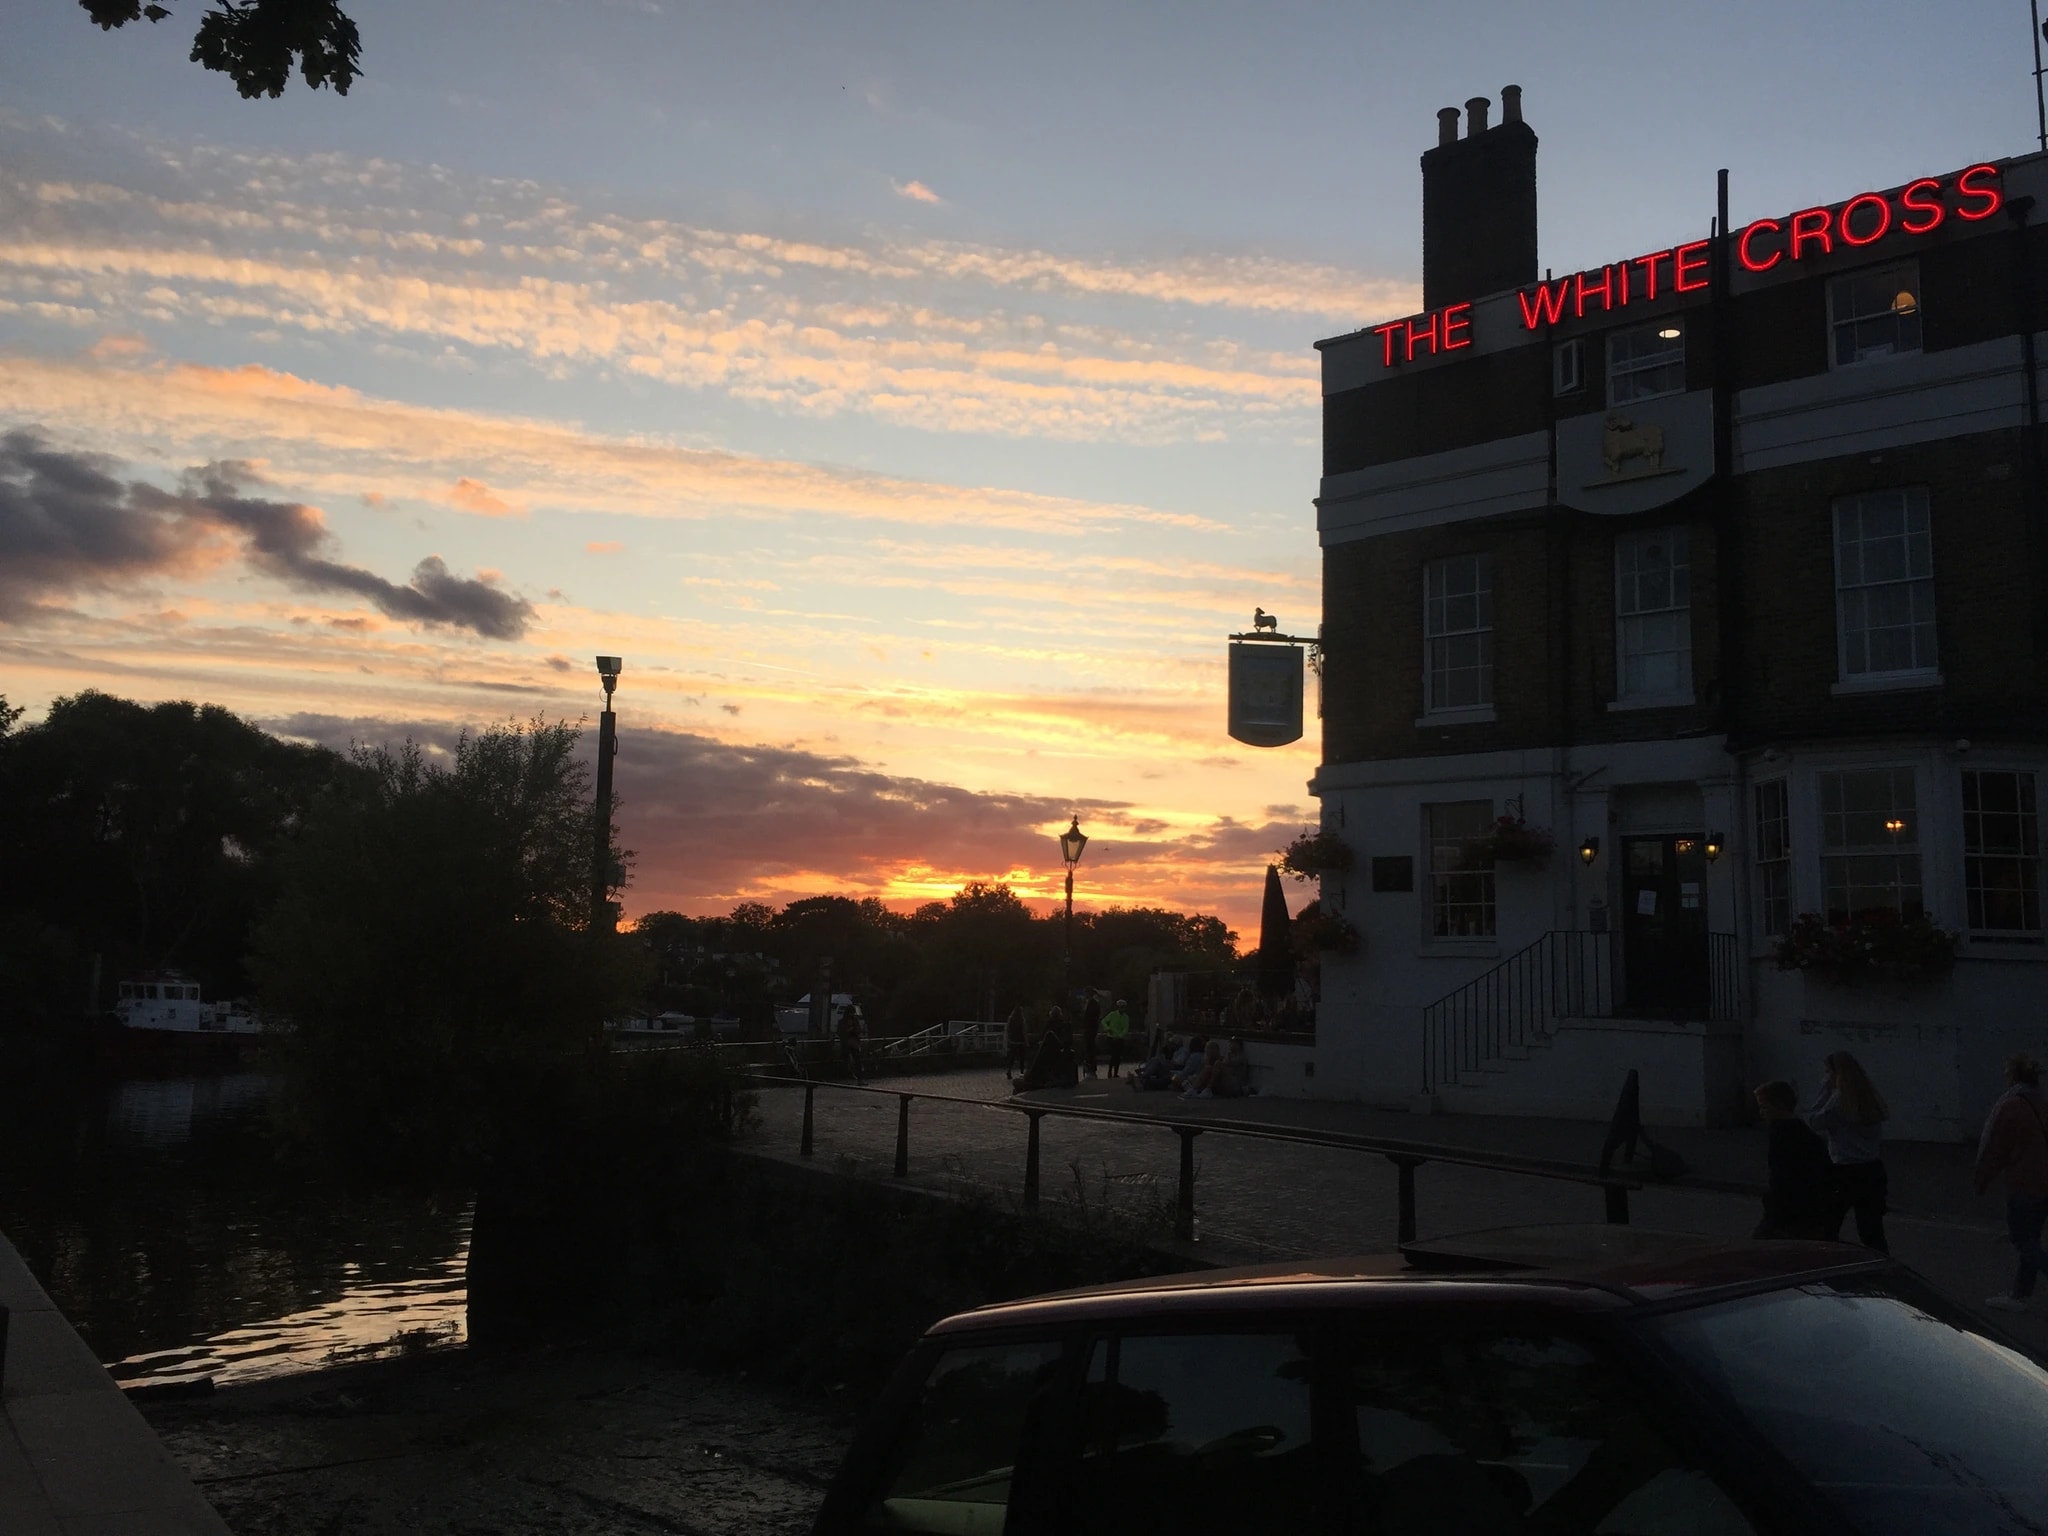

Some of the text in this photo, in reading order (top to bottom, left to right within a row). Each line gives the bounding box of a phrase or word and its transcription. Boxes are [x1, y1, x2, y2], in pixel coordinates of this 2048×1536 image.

[1374, 164, 2002, 366] THE WHITE CROSS
